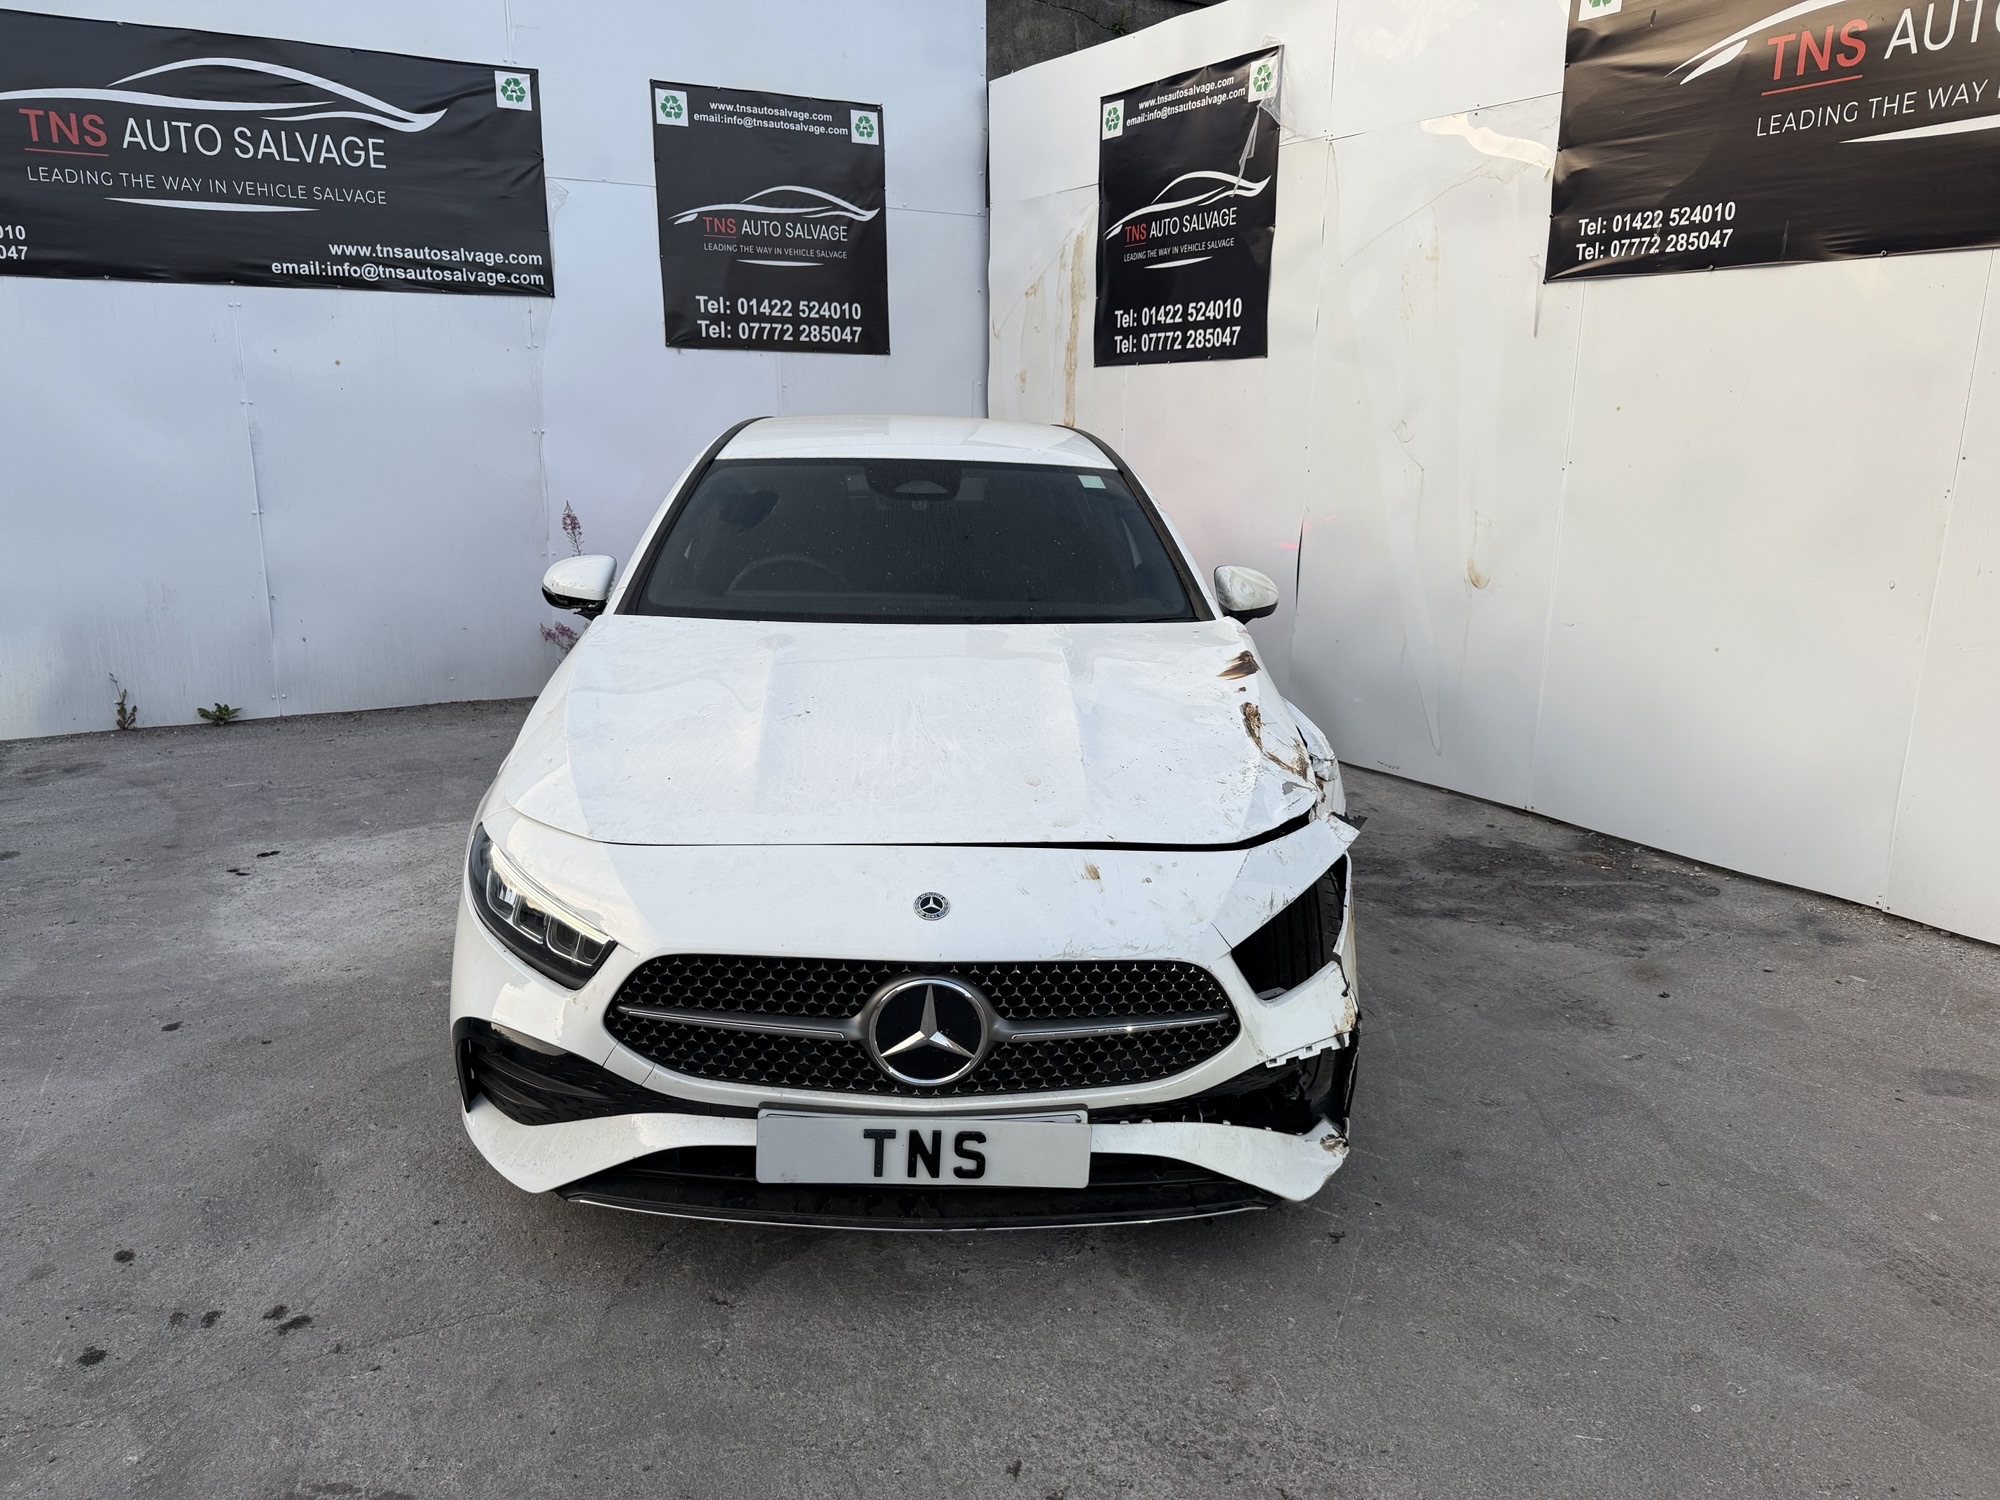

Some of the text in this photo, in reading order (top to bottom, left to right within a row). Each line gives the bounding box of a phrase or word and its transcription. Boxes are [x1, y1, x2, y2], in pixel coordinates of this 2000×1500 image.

[1767, 0, 2000, 81] TNS AUT
[1126, 86, 1246, 127] email:info@tnsautosalvage.com
[1138, 76, 1235, 110] www.tnsautosalvage.com
[1755, 100, 1860, 137] LEADING
[1869, 90, 1918, 119] THE
[1927, 78, 1988, 108] WAY
[693, 112, 849, 136] email:info@tnsautosalvage.com
[709, 101, 833, 123] www.tnsautosalvage.com
[18, 108, 387, 170] TNS AUTO SALVAGE
[26, 165, 387, 205] LEADING THE WAY IN VEHICLE SALVAGE
[703, 216, 848, 242] TNS AUTO SALVAGE
[1124, 206, 1237, 242] TNS AUTO SALVAGE
[1578, 200, 1737, 237] Tel: 01422 524010
[328, 241, 543, 267] www.tnsautosalvage.com
[703, 242, 848, 259] LEADING THE WAY IN VEHICLE SALVAGE
[1123, 237, 1235, 262] LEADING THE WAY IN VEHICLE SALVAGE
[1576, 228, 1734, 261] Tel: 07772 285047
[271, 260, 545, 287] email:info@tnsautosalvage.com
[695, 295, 862, 320] Tel: 01422 524010
[1114, 297, 1243, 329] Tel: 01422 524010
[697, 320, 863, 343] Tel: 07772 285047
[1114, 326, 1241, 354] Tel: 07772 285047
[863, 1128, 987, 1179] TNS
